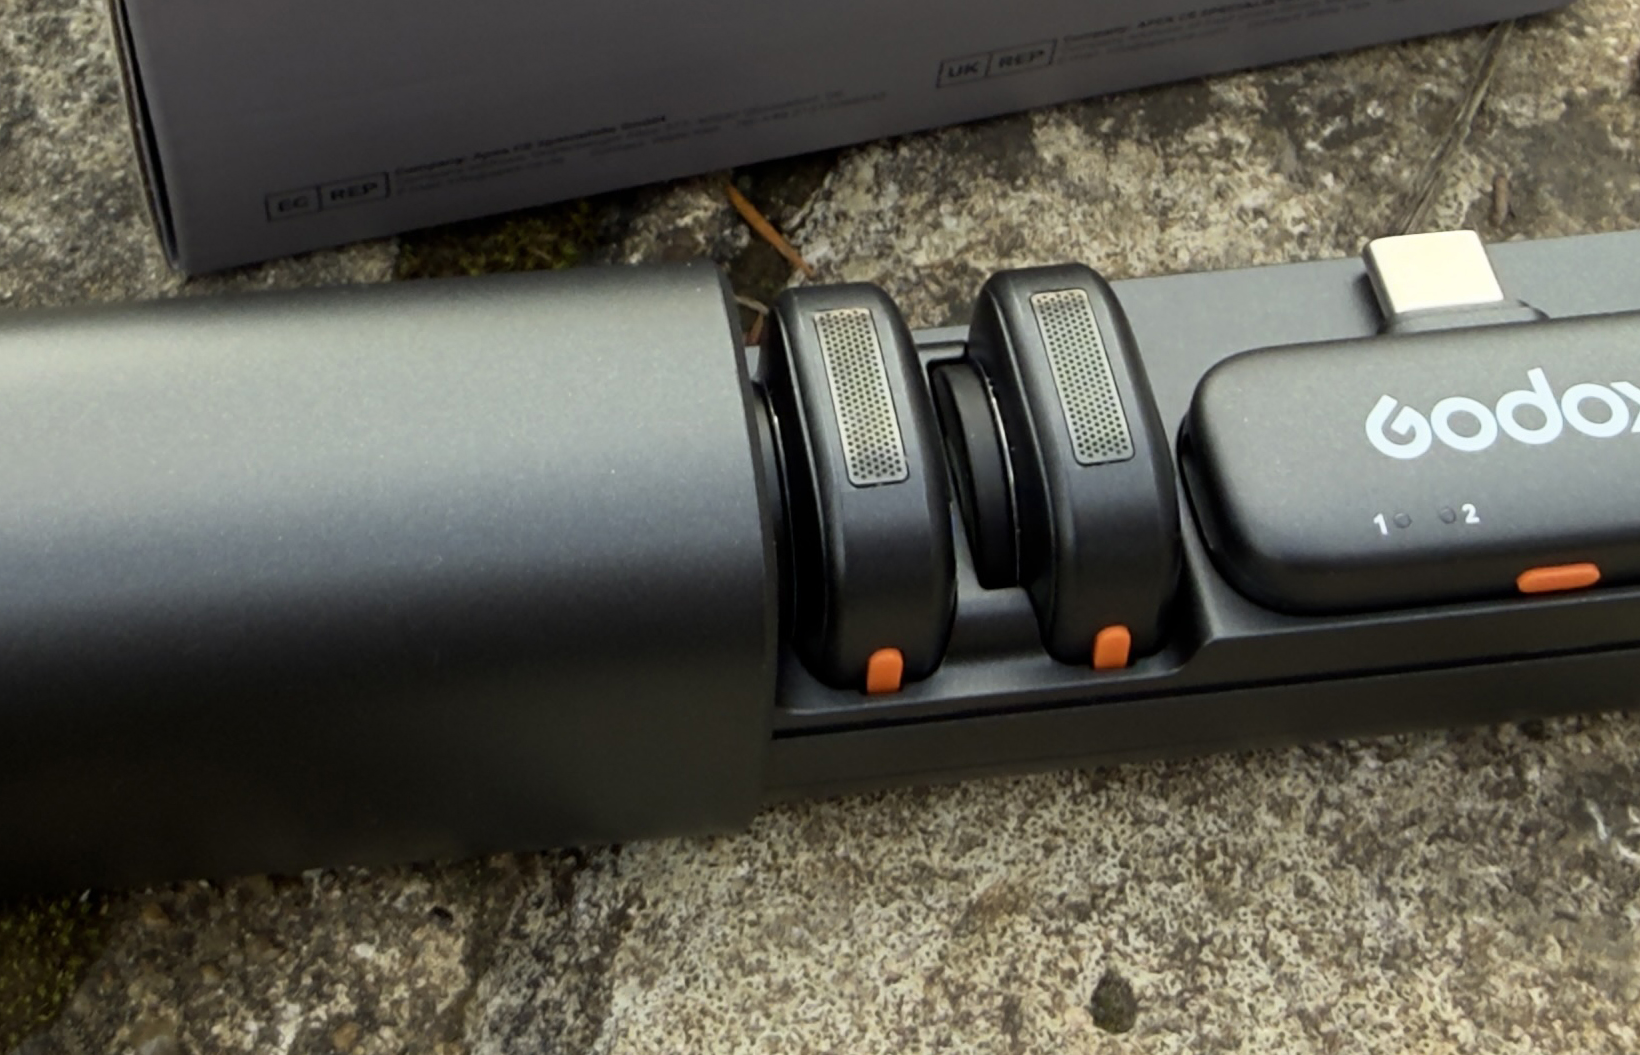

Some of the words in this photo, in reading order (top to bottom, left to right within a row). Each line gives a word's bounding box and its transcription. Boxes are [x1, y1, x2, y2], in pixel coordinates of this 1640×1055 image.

[998, 49, 1046, 68] REP
[277, 195, 310, 213] EC
[329, 182, 378, 201] REP
[1373, 512, 1389, 535] 1
[1461, 503, 1481, 525] 2
